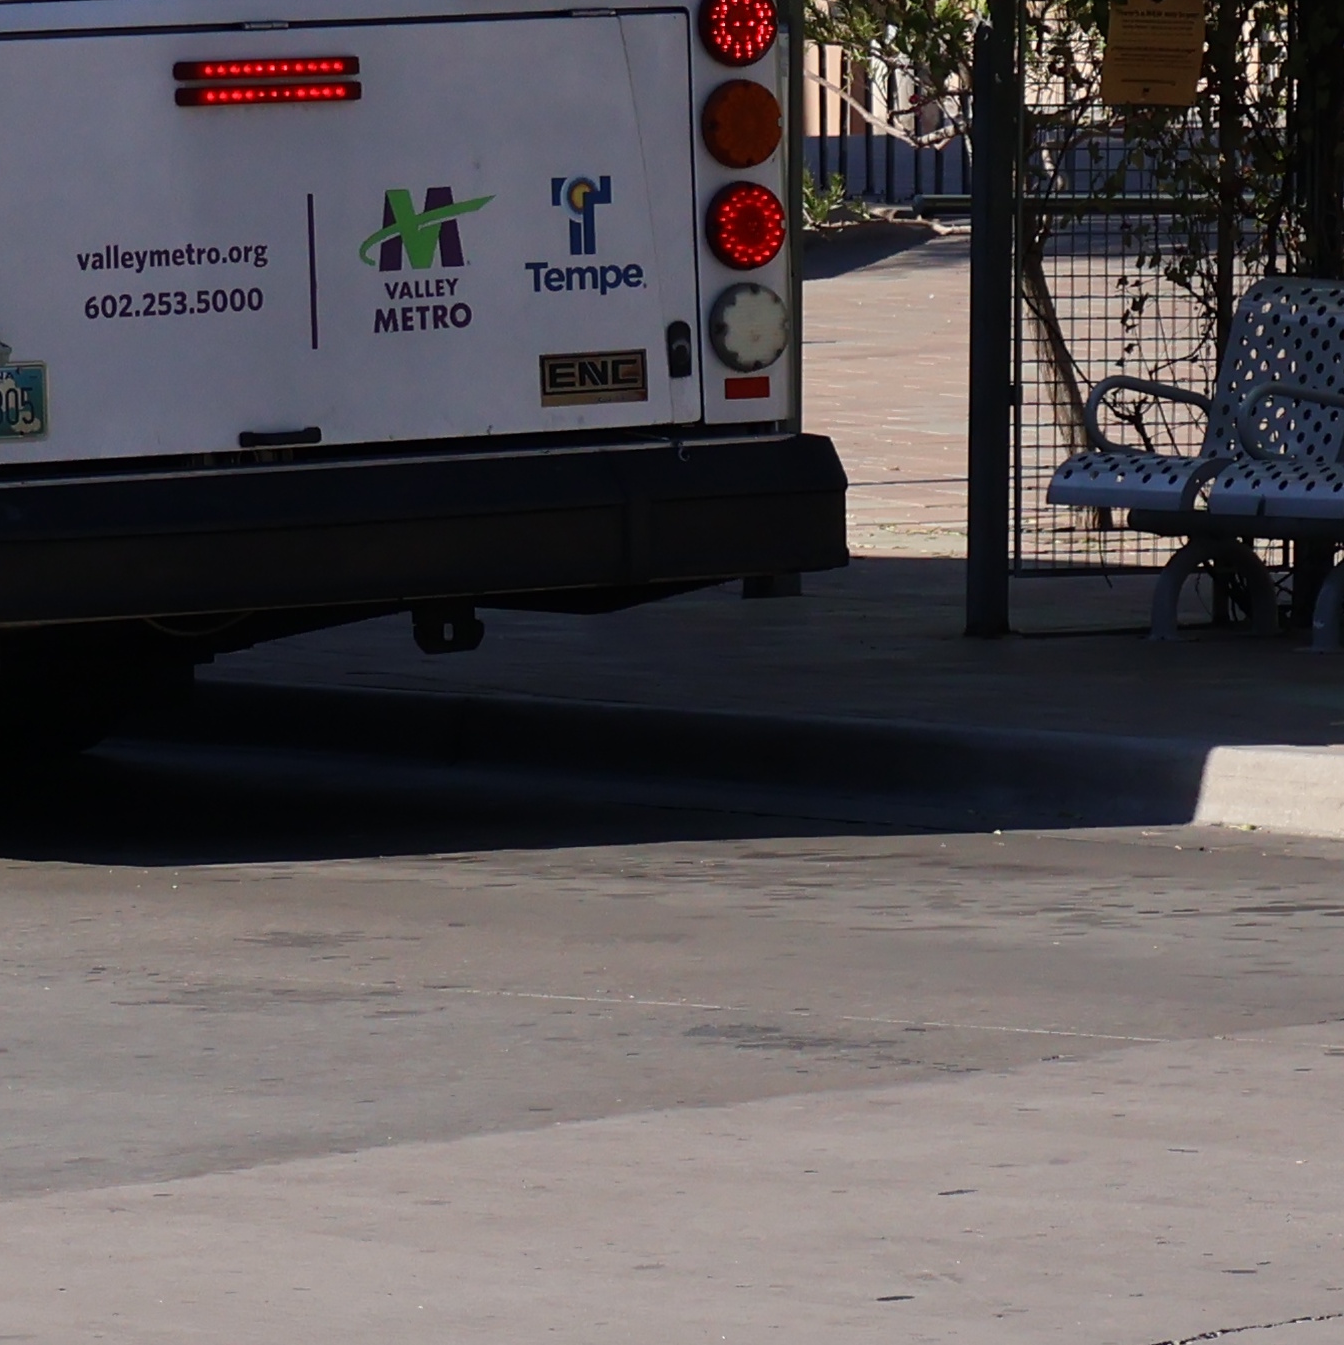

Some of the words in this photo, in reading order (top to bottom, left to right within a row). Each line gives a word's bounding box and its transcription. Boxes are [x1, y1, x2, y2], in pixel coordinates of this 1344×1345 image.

[76, 243, 269, 273] valleymetro.org
[384, 278, 459, 301] VALLEY
[524, 261, 644, 296] Tempe
[84, 287, 264, 320] 602.253.5000
[373, 302, 473, 333] METRO
[549, 359, 639, 388] ENC
